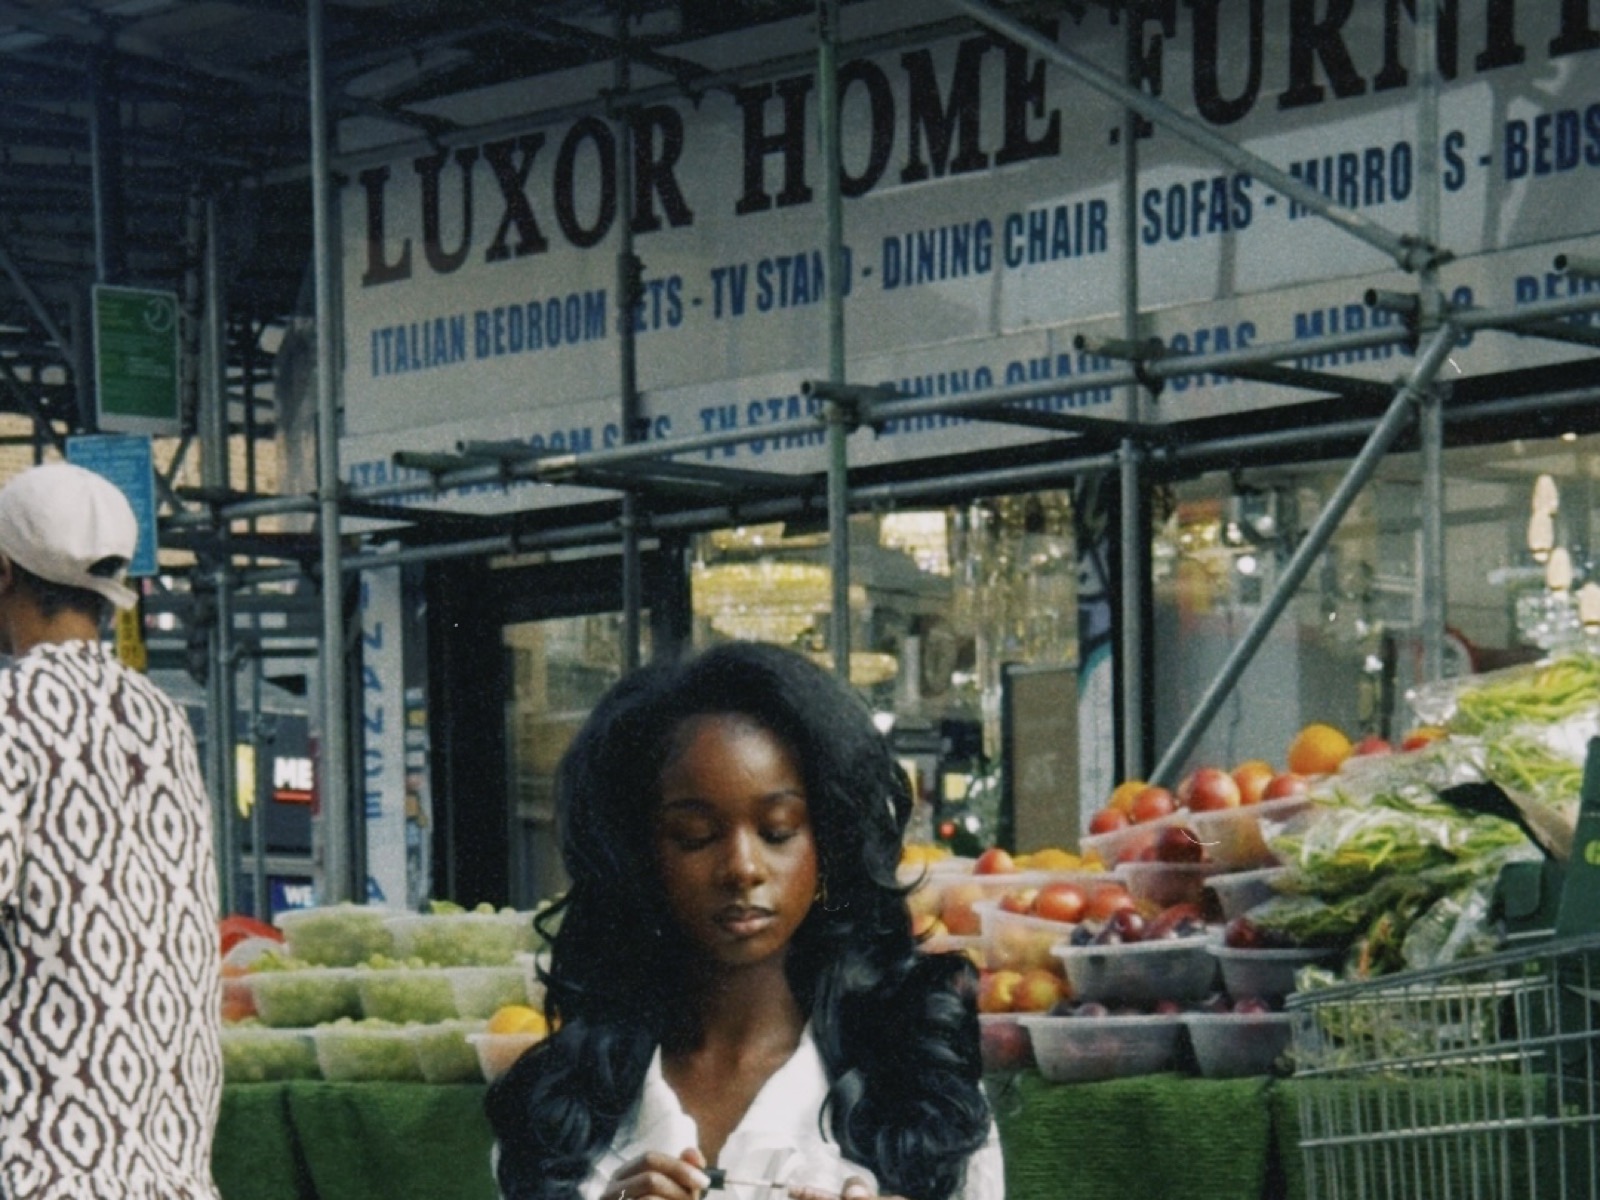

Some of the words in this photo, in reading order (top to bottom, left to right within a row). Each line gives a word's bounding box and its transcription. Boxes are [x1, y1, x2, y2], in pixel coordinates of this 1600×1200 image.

[361, 103, 693, 286] LUXOR
[735, 20, 1062, 215] HOME
[372, 314, 465, 377] ITALIAN
[475, 289, 606, 358] BEDROOM
[619, 275, 683, 332] ETS
[710, 263, 748, 319] TV
[883, 218, 993, 290] DINING
[1004, 199, 1107, 268] CHAIR
[1142, 172, 1252, 245] SOFAS
[1289, 130, 1465, 219] MIRROS
[1506, 103, 1600, 180] BEDS
